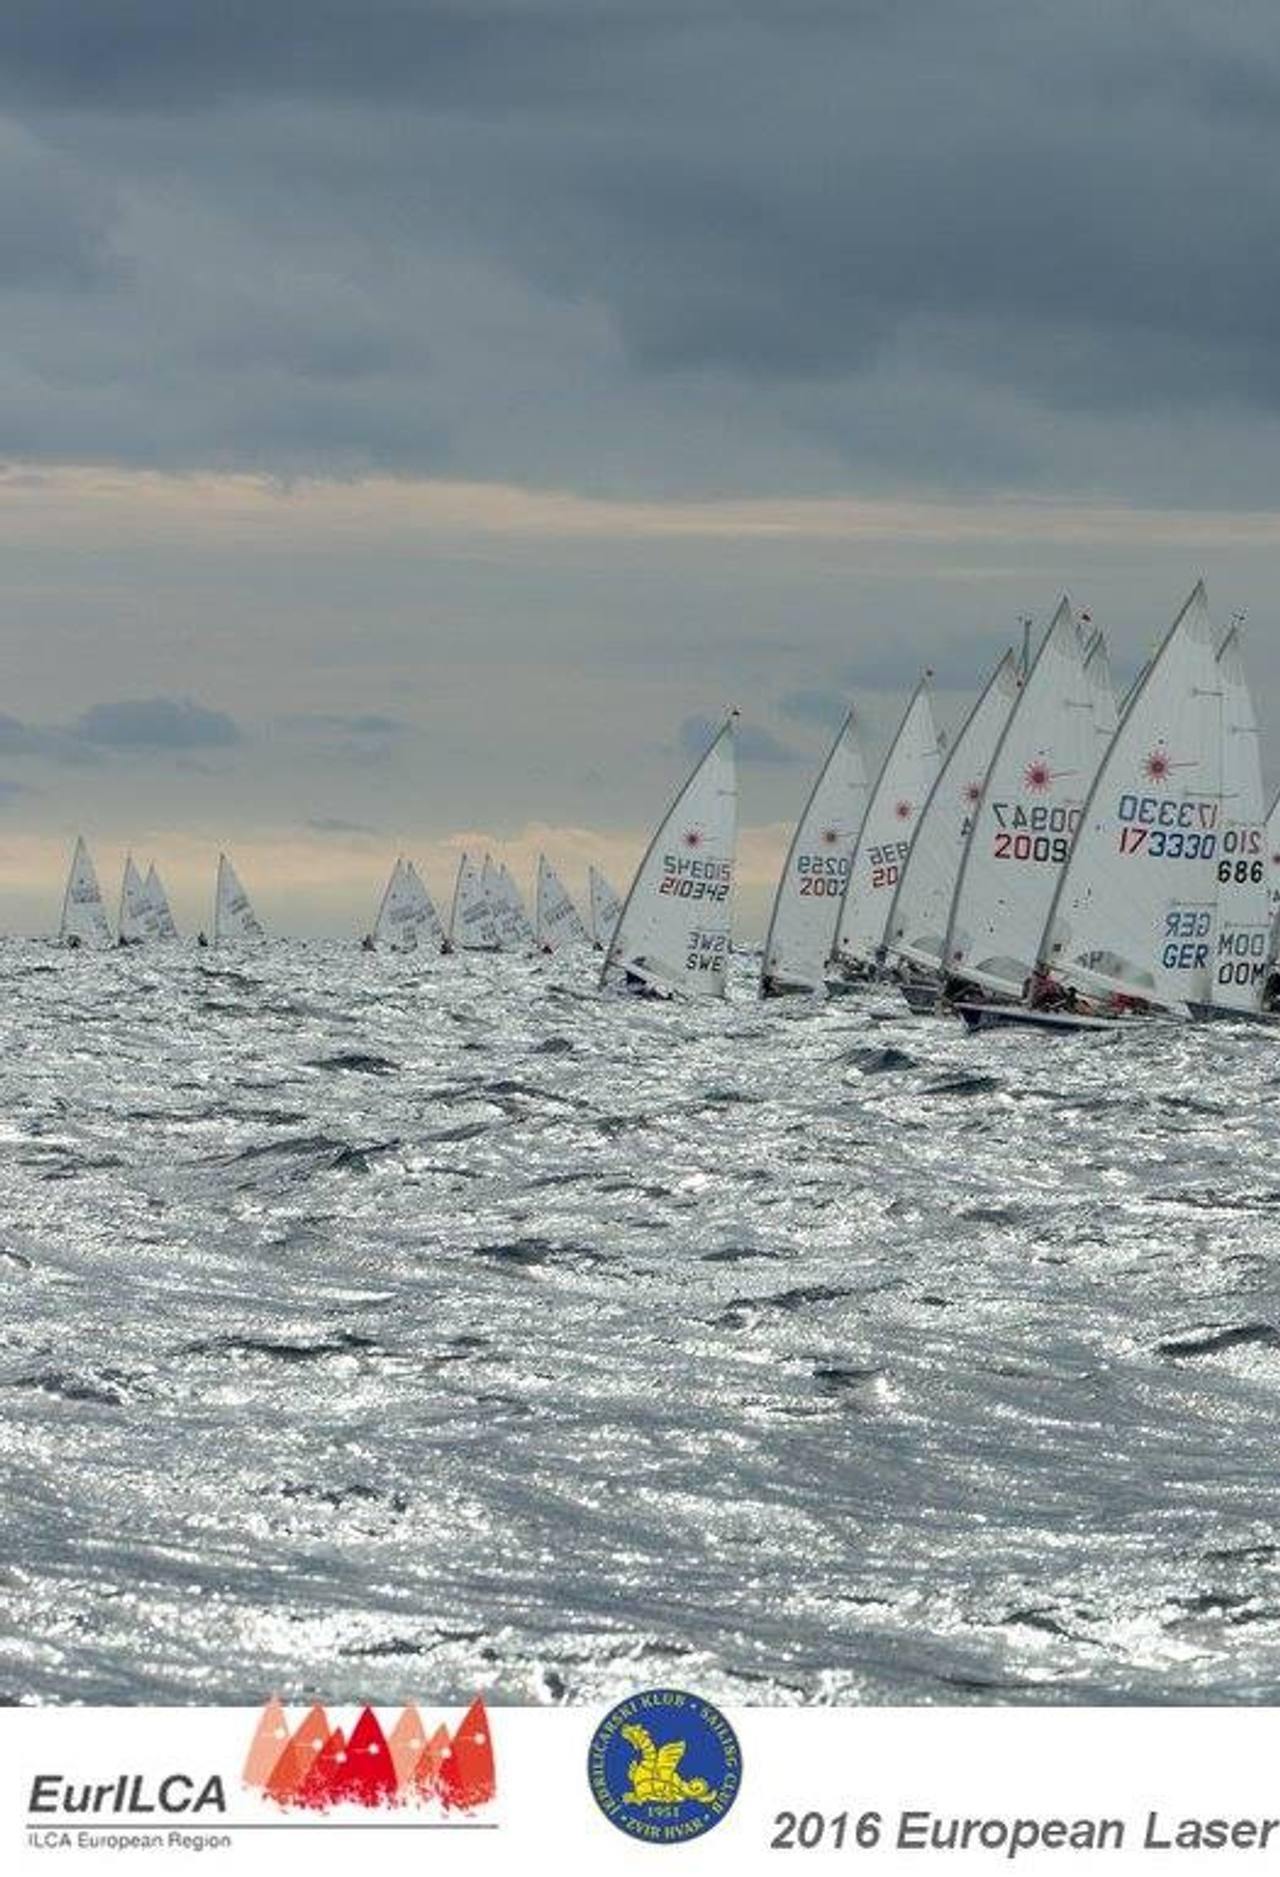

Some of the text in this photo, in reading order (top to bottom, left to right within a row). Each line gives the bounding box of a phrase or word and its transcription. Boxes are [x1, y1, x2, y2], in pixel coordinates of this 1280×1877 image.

[994, 833, 1068, 862] 2009
[1118, 828, 1216, 860] 173330
[1217, 861, 1263, 883] 686
[659, 876, 730, 901] 210342
[685, 953, 724, 972] SWE
[1162, 945, 1208, 969] GER
